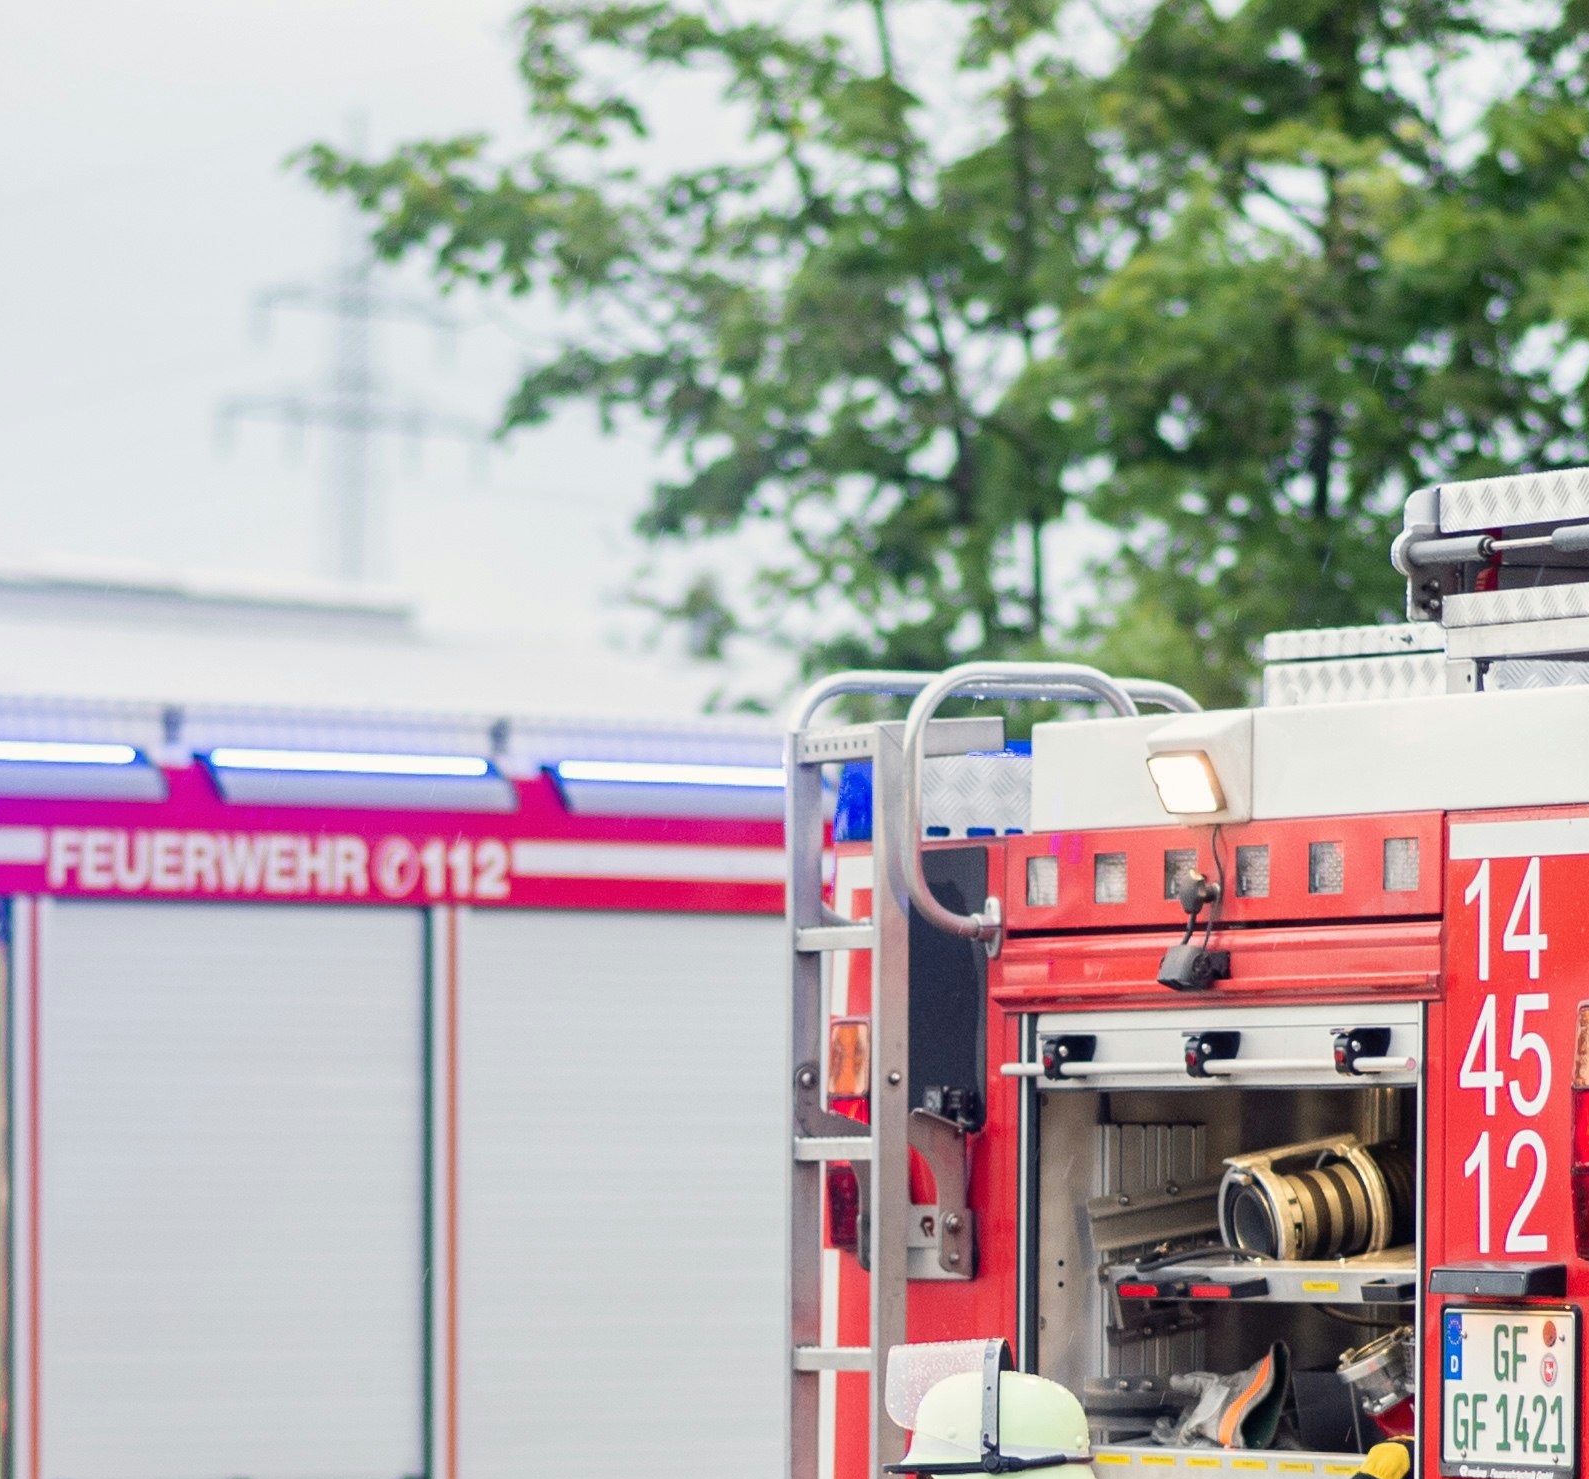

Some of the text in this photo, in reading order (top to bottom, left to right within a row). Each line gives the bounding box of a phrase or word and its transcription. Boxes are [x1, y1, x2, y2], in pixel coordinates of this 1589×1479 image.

[48, 828, 510, 899] FEUERWEHR 112
[1464, 857, 1548, 982] 14
[1459, 994, 1552, 1117] 45
[1463, 1130, 1548, 1254] 12
[1450, 1355, 1458, 1373] D
[1493, 1324, 1529, 1383] GF
[1453, 1393, 1566, 1454] GF 1421
